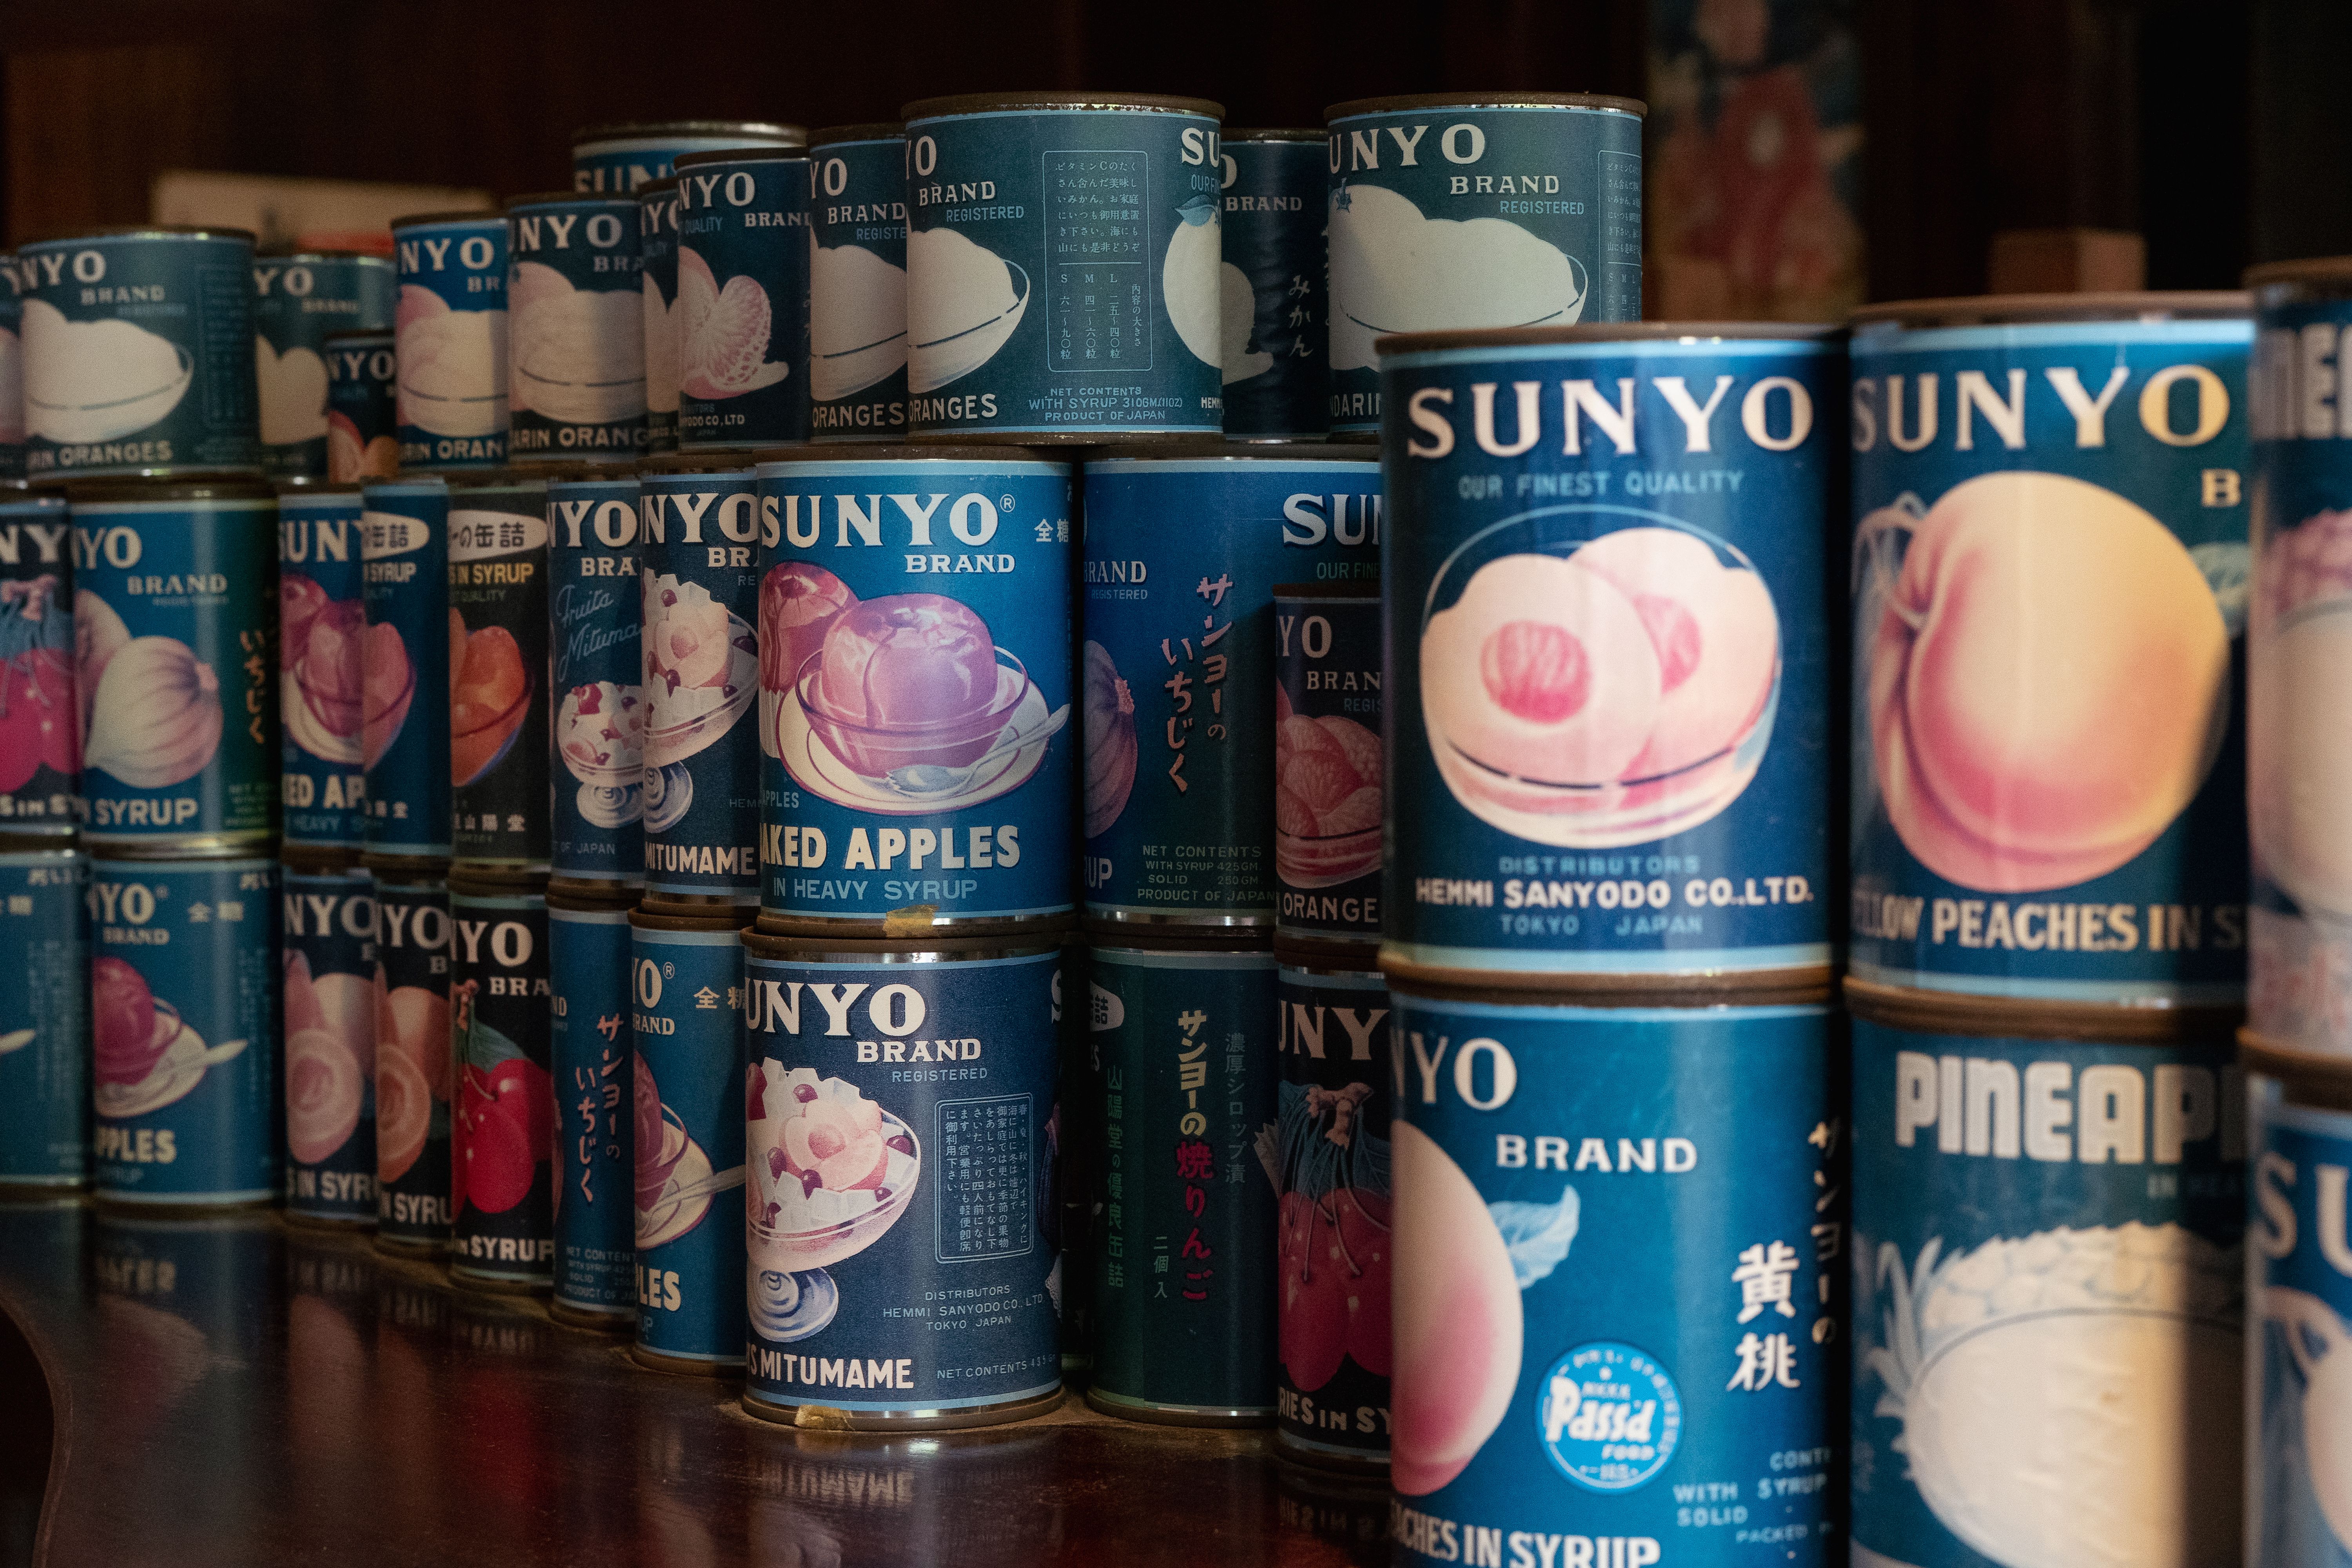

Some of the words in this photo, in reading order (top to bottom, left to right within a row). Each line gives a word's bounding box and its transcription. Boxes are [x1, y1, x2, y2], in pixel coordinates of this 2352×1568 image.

[1330, 124, 1486, 174] UNYO
[679, 172, 755, 211] NYO
[919, 181, 996, 207] BRAND
[1450, 175, 1559, 195] BRAND
[828, 203, 907, 225] BRAND
[946, 206, 1024, 222] REGISTERED
[1225, 196, 1303, 212] BRAND
[1500, 200, 1584, 216] REGISTERED
[400, 236, 495, 274] NYO
[1051, 388, 1073, 396] NET
[1079, 387, 1142, 396] CONTENTS
[909, 394, 998, 422] ORANGES
[1029, 397, 1063, 410] WITH
[1069, 397, 1117, 409] SYRUP
[1851, 364, 2230, 453] SUNYO
[812, 403, 905, 428] ORANGES
[1045, 411, 1105, 421] PRODUCT
[1110, 411, 1123, 420] OF
[1127, 410, 1166, 420] JAPAN
[1407, 376, 1814, 459] SUNYO
[1458, 474, 1504, 500] OUR
[1516, 472, 1611, 497] FINEST
[1624, 470, 1746, 495] QUALITY
[761, 492, 998, 548] SUNYO
[708, 546, 759, 568] BR
[905, 555, 1016, 573] BRAND
[473, 563, 534, 584] SYRUP
[1316, 562, 1349, 579] OUR
[127, 573, 228, 595] BRAND
[1091, 588, 1148, 600] REGISTERED
[1279, 615, 1332, 658] YO
[1197, 573, 1233, 740] サンヨーの
[1161, 638, 1194, 793] いちじく
[95, 797, 198, 826] SYRUP
[845, 824, 1021, 871] APPLES
[1143, 845, 1167, 857] NET
[1175, 845, 1262, 858] CONTENTS
[1146, 860, 1173, 870] WITH
[1176, 861, 1214, 871] SYRUP
[1499, 855, 1700, 875] DISTRIBUTORS
[773, 877, 785, 897] IN
[795, 878, 868, 900] HEAVY
[884, 880, 977, 900] SYRUP
[1148, 874, 1188, 885] SOLID
[1138, 889, 1198, 901] PRODUCT
[1204, 891, 1221, 901] OF
[1416, 877, 1494, 907] HEMMI
[1504, 879, 1671, 910] SANYODO
[1500, 914, 1580, 936] TOKYO
[1615, 915, 1703, 936] JAPAN
[1932, 897, 2140, 953] PEACHES
[745, 976, 926, 1037] UNYO
[857, 1038, 982, 1063] BRAND
[597, 1013, 624, 1159] サンヨーの
[892, 1067, 987, 1083] REGISTERED
[1225, 1032, 1247, 1183] 濃厚シロップ漬
[576, 1066, 596, 1203] いちじく
[1496, 1133, 1698, 1173] BRAND
[925, 1285, 1010, 1301] DISTRIBUTORS
[883, 1307, 931, 1318] HEMMI
[939, 1301, 1000, 1316] SANYODO
[1726, 1240, 1802, 1392] 黄桃
[926, 1320, 967, 1331] TOKYO
[975, 1316, 1012, 1328] JAPAN
[760, 1348, 915, 1389] MITUMAME
[937, 1368, 962, 1379] NET
[965, 1361, 1027, 1377] CONTENTS
[1673, 1482, 1739, 1504] WITH
[1677, 1505, 1748, 1528] SOLID
[1463, 1524, 1502, 1568] IN
